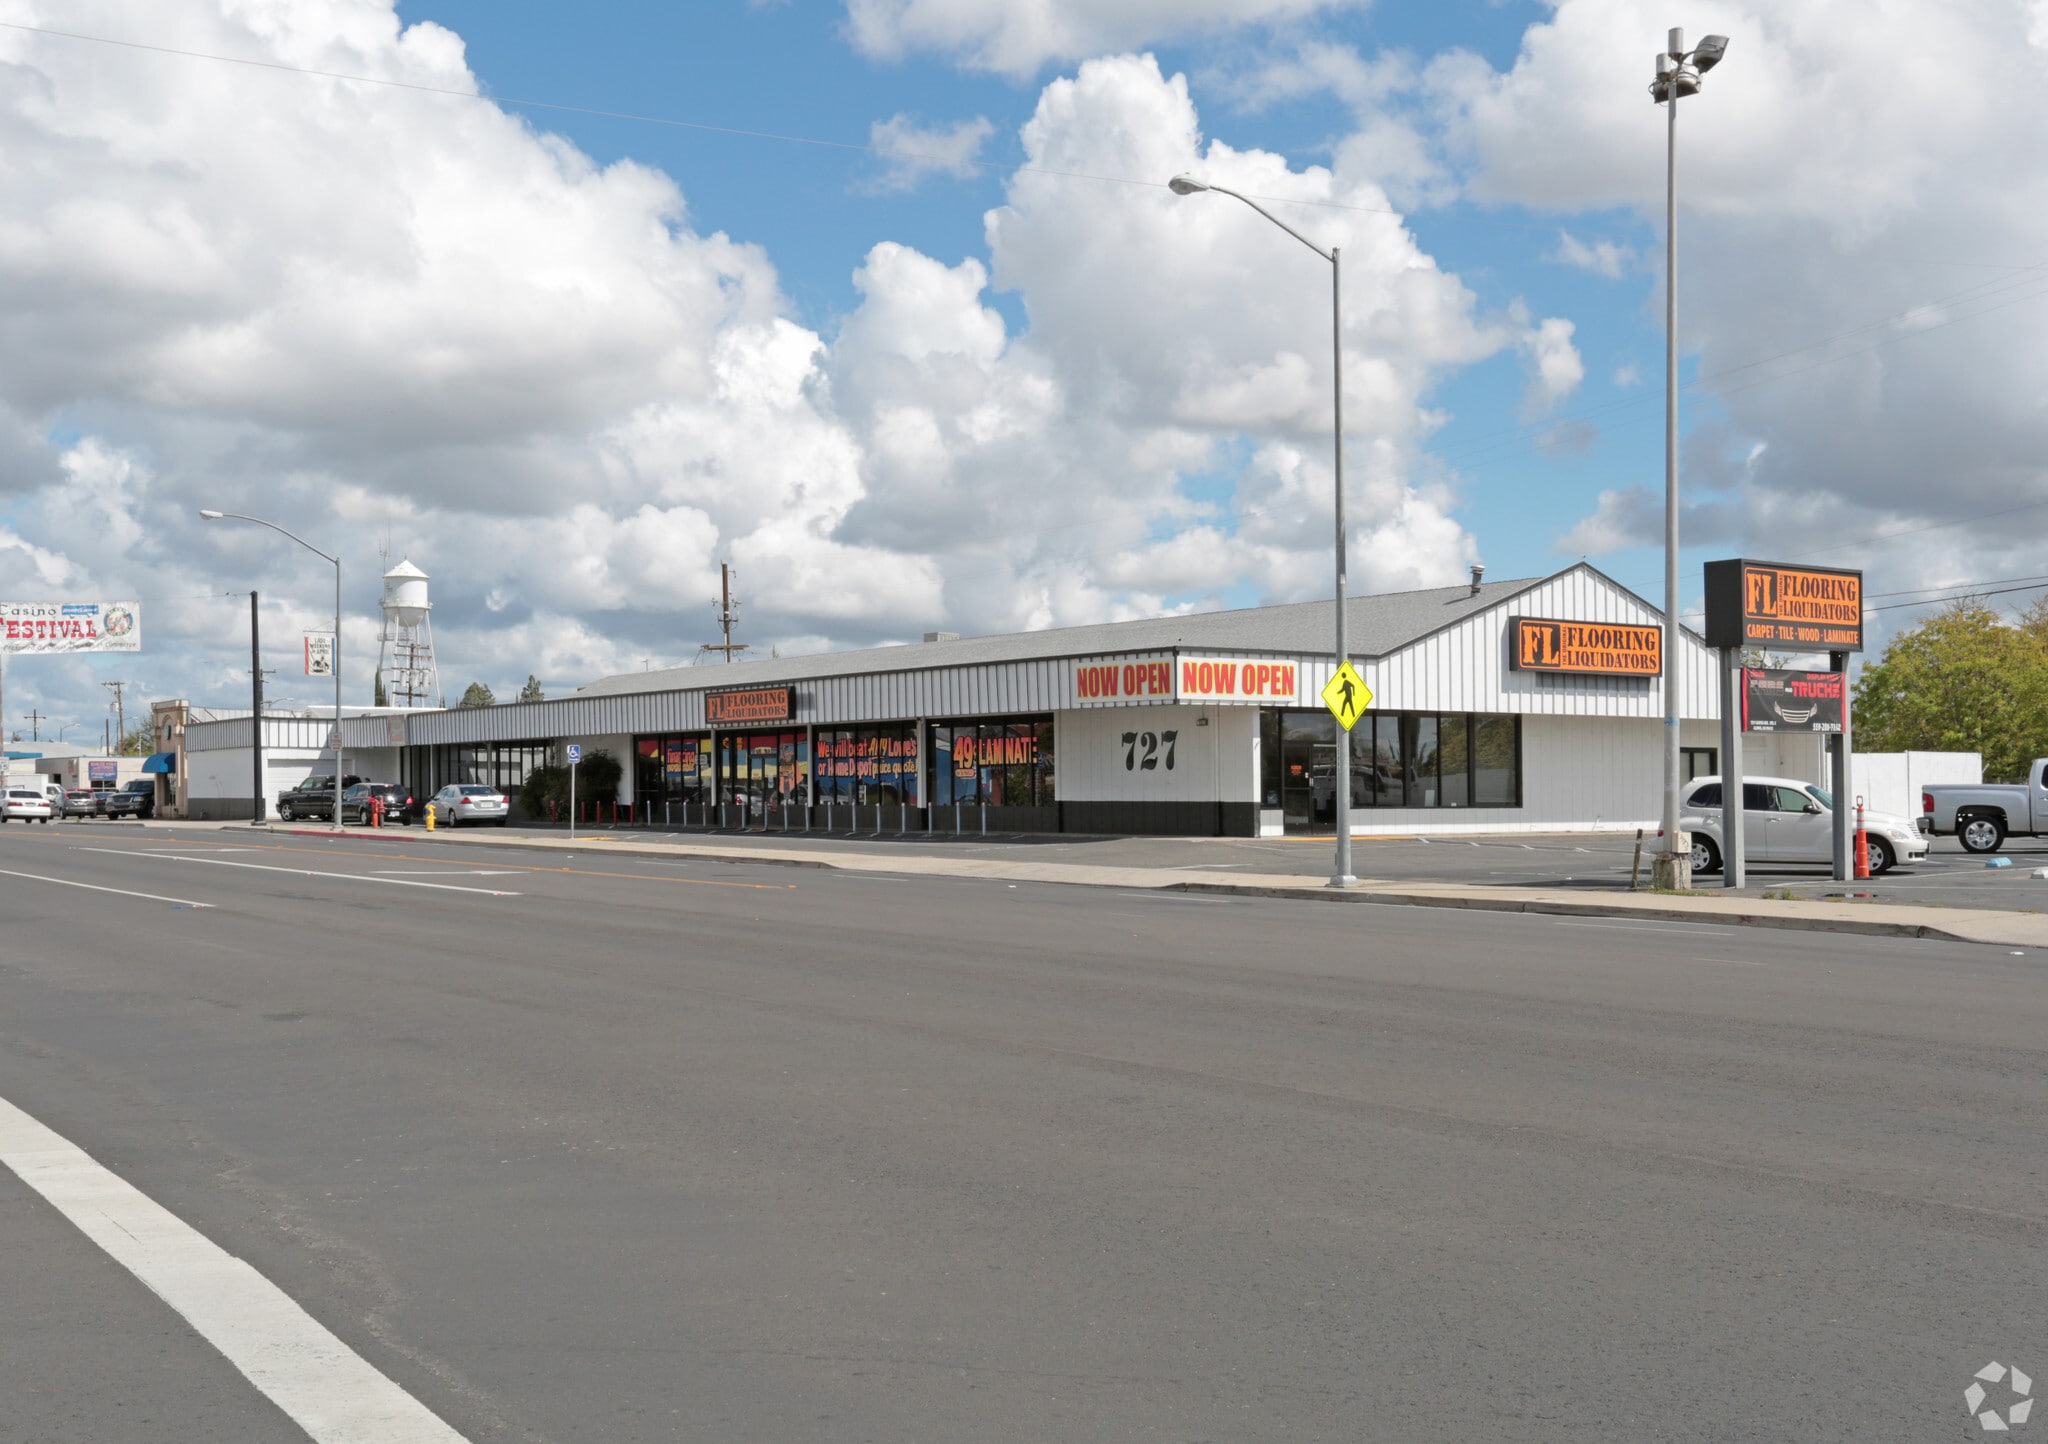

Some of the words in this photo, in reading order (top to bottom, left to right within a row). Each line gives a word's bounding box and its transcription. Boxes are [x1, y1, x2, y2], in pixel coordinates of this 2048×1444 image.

[1747, 573, 1777, 615] FL
[1783, 575, 1856, 602] FLOORING
[0, 604, 57, 617] Casino
[1783, 600, 1857, 622] LIQUIDATORS
[1567, 627, 1656, 652] FLOORING
[1746, 624, 1775, 639] CARPET
[1778, 626, 1795, 641] TILE
[1798, 627, 1820, 642] WOOD
[1824, 629, 1859, 644] LAMINATE
[1522, 625, 1559, 665] FL
[1567, 650, 1657, 670] LIQUIDATORS
[1077, 665, 1119, 698] NOW
[1123, 662, 1170, 697] OPEN
[1183, 662, 1237, 694] NOW
[1242, 663, 1294, 696] OPEN
[727, 691, 785, 707] FLOORING
[1791, 681, 1841, 699] TRUCKS
[727, 706, 786, 718] LIQUIDATORS
[818, 741, 830, 758] We
[1121, 730, 1179, 771] 727
[818, 763, 827, 776] or
